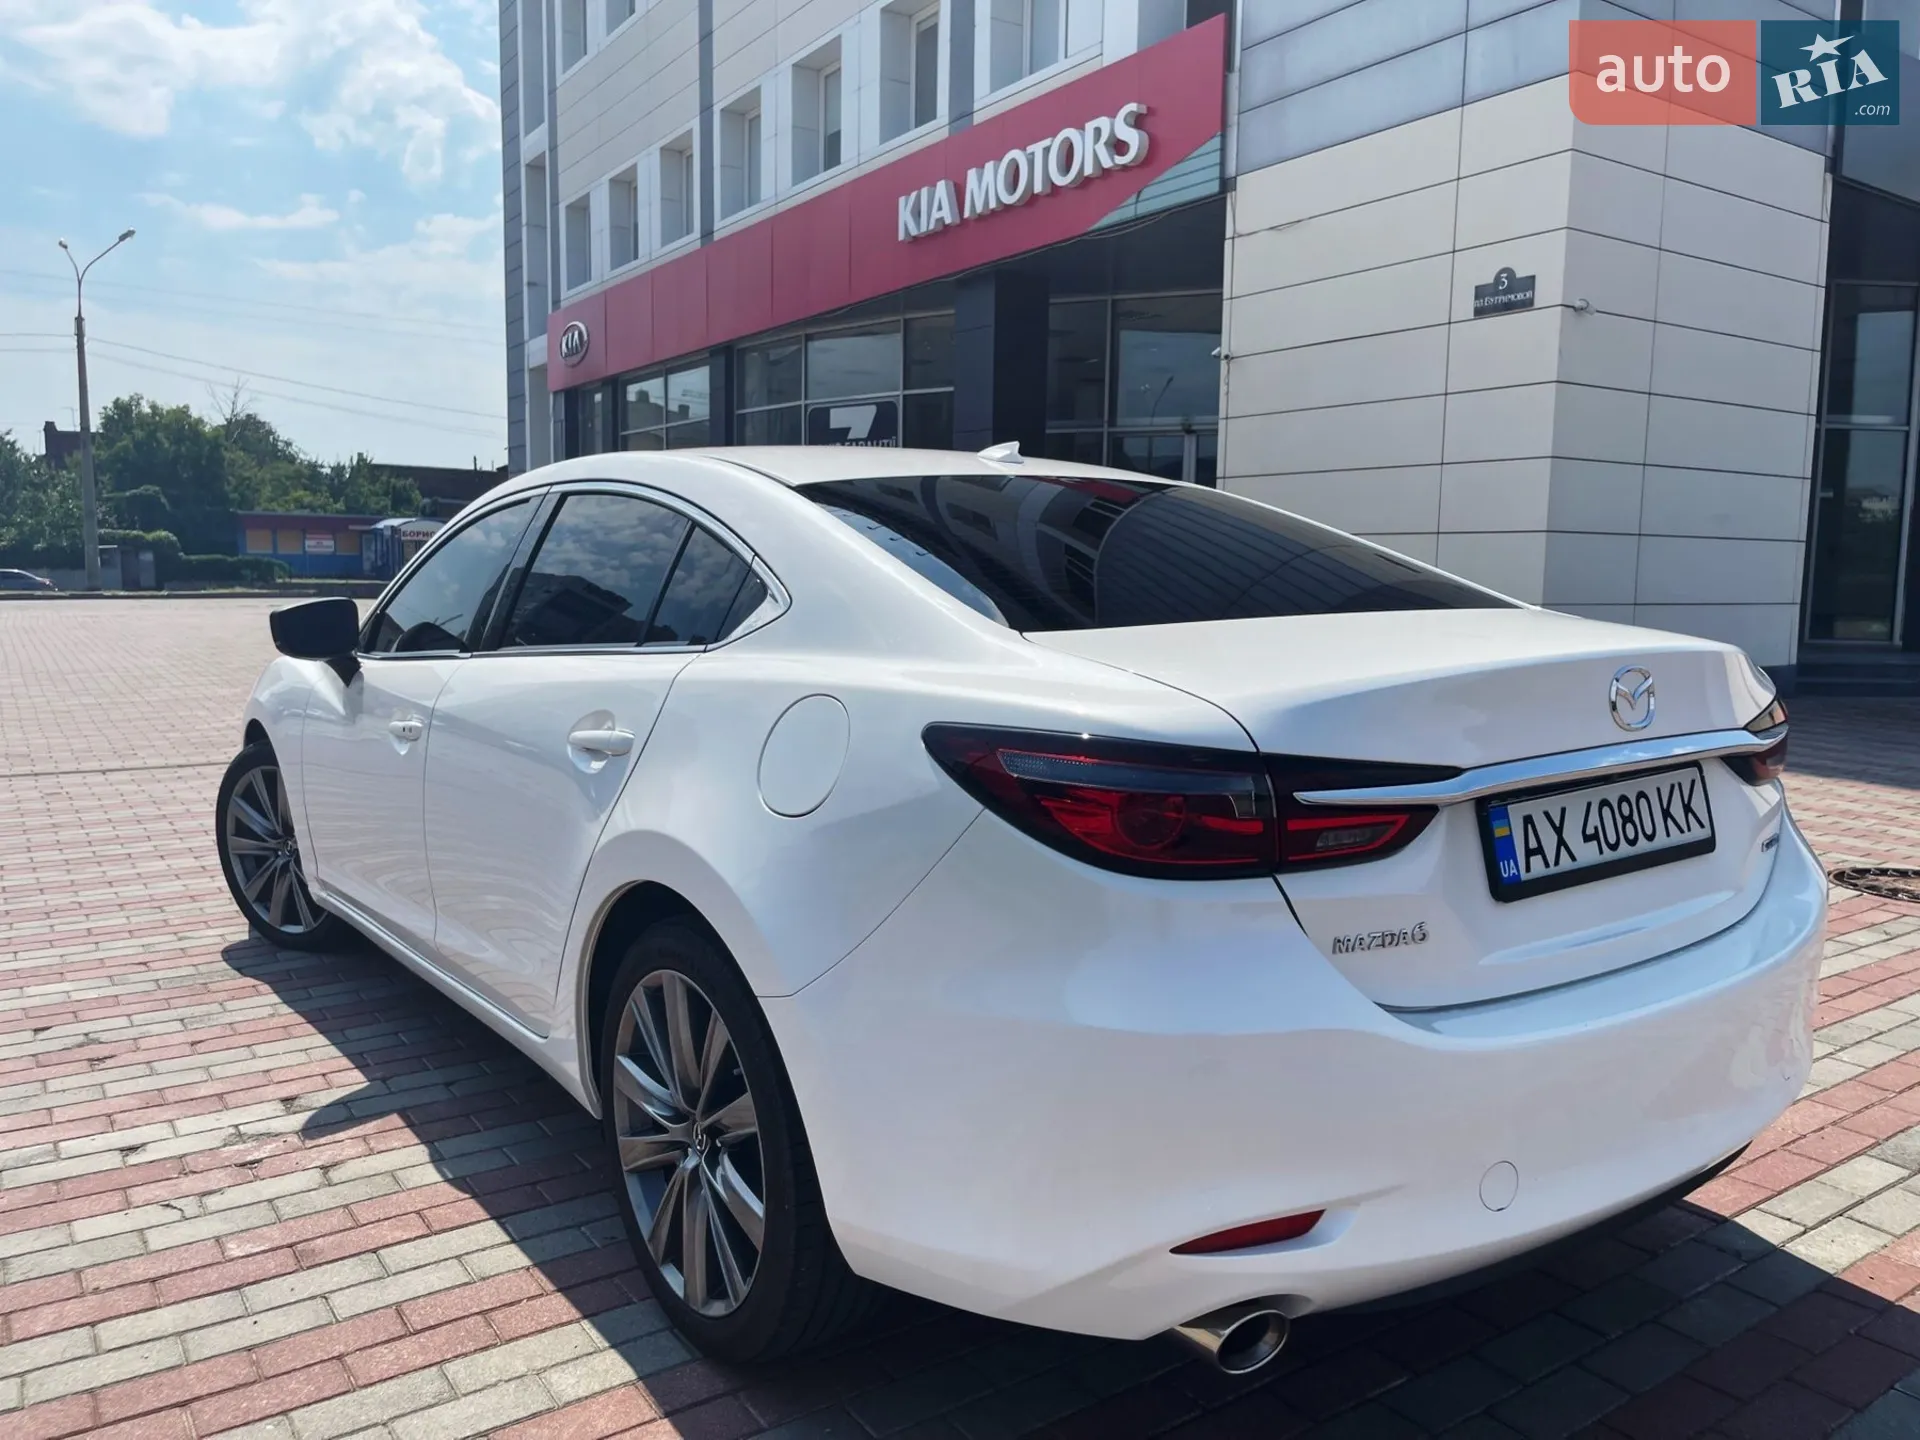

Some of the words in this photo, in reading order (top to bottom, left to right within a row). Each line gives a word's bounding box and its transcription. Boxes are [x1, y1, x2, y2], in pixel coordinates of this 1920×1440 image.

[898, 179, 960, 242] KIA
[964, 102, 1149, 219] MOTORS
[829, 404, 877, 440] 7
[1522, 806, 1577, 873] AX
[1500, 859, 1518, 878] UA
